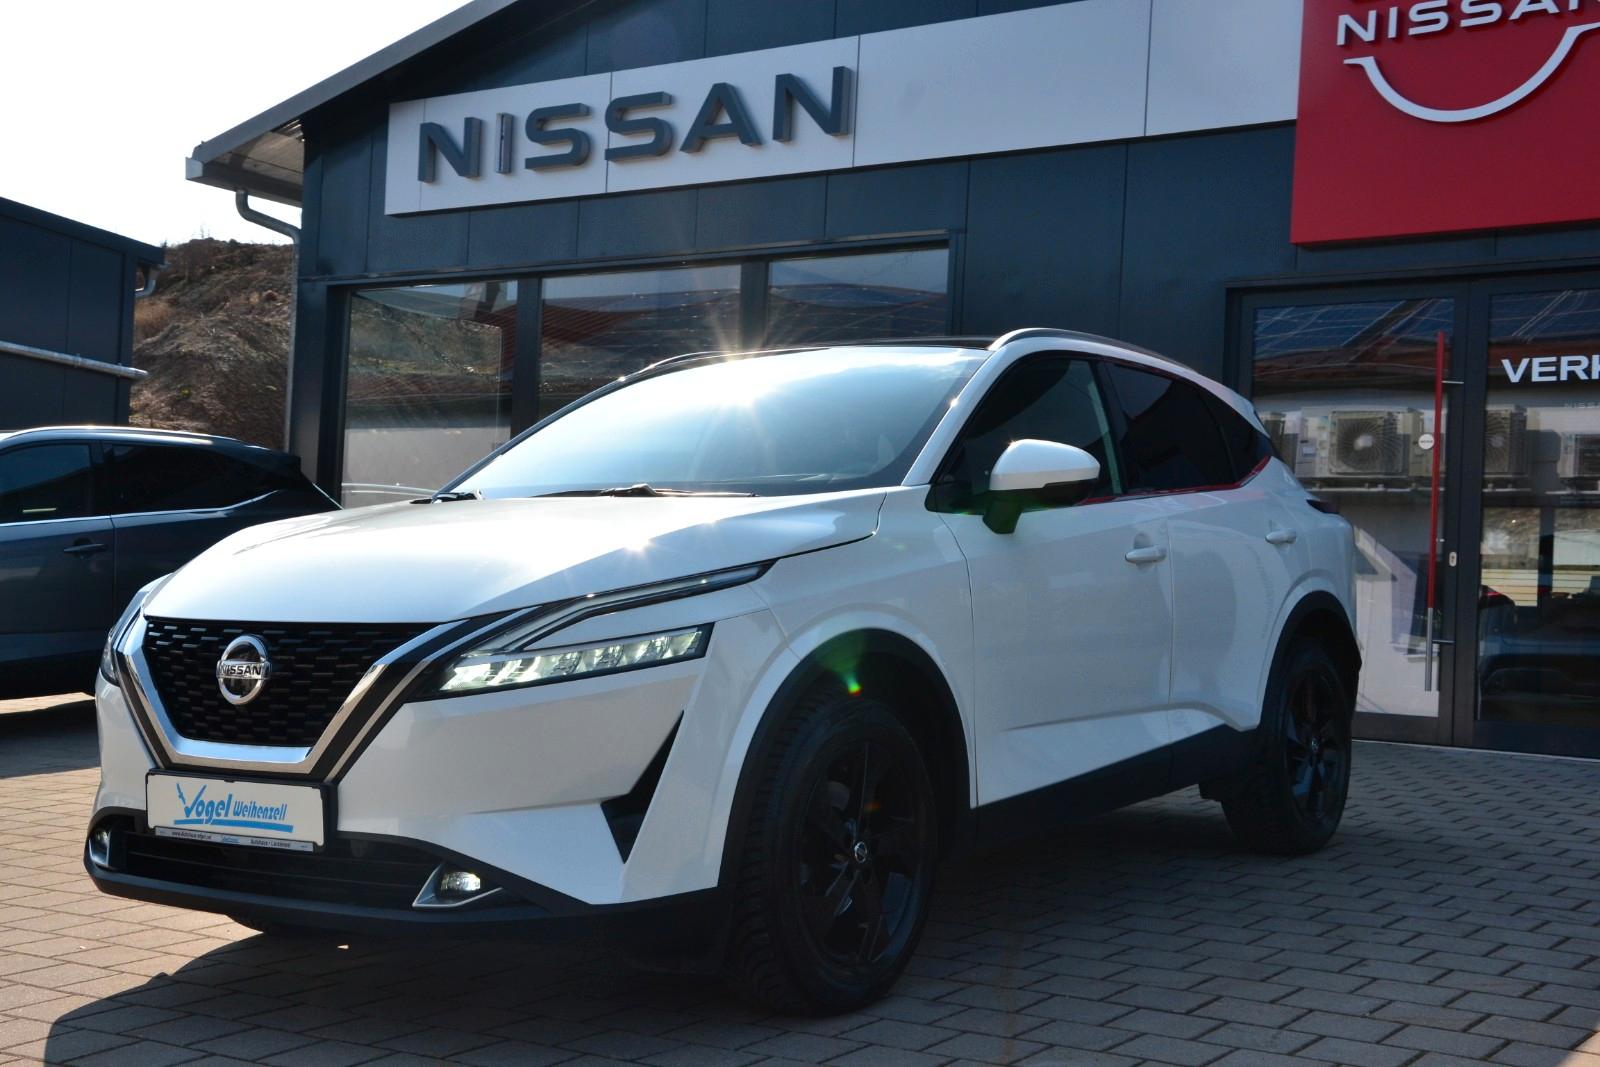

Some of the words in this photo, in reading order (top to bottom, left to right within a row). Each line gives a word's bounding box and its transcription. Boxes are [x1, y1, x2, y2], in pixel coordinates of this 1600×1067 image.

[418, 66, 851, 183] NISSAN
[220, 664, 262, 675] NISSAN
[176, 783, 233, 825] Vogel
[233, 801, 288, 821] Weihenzell
